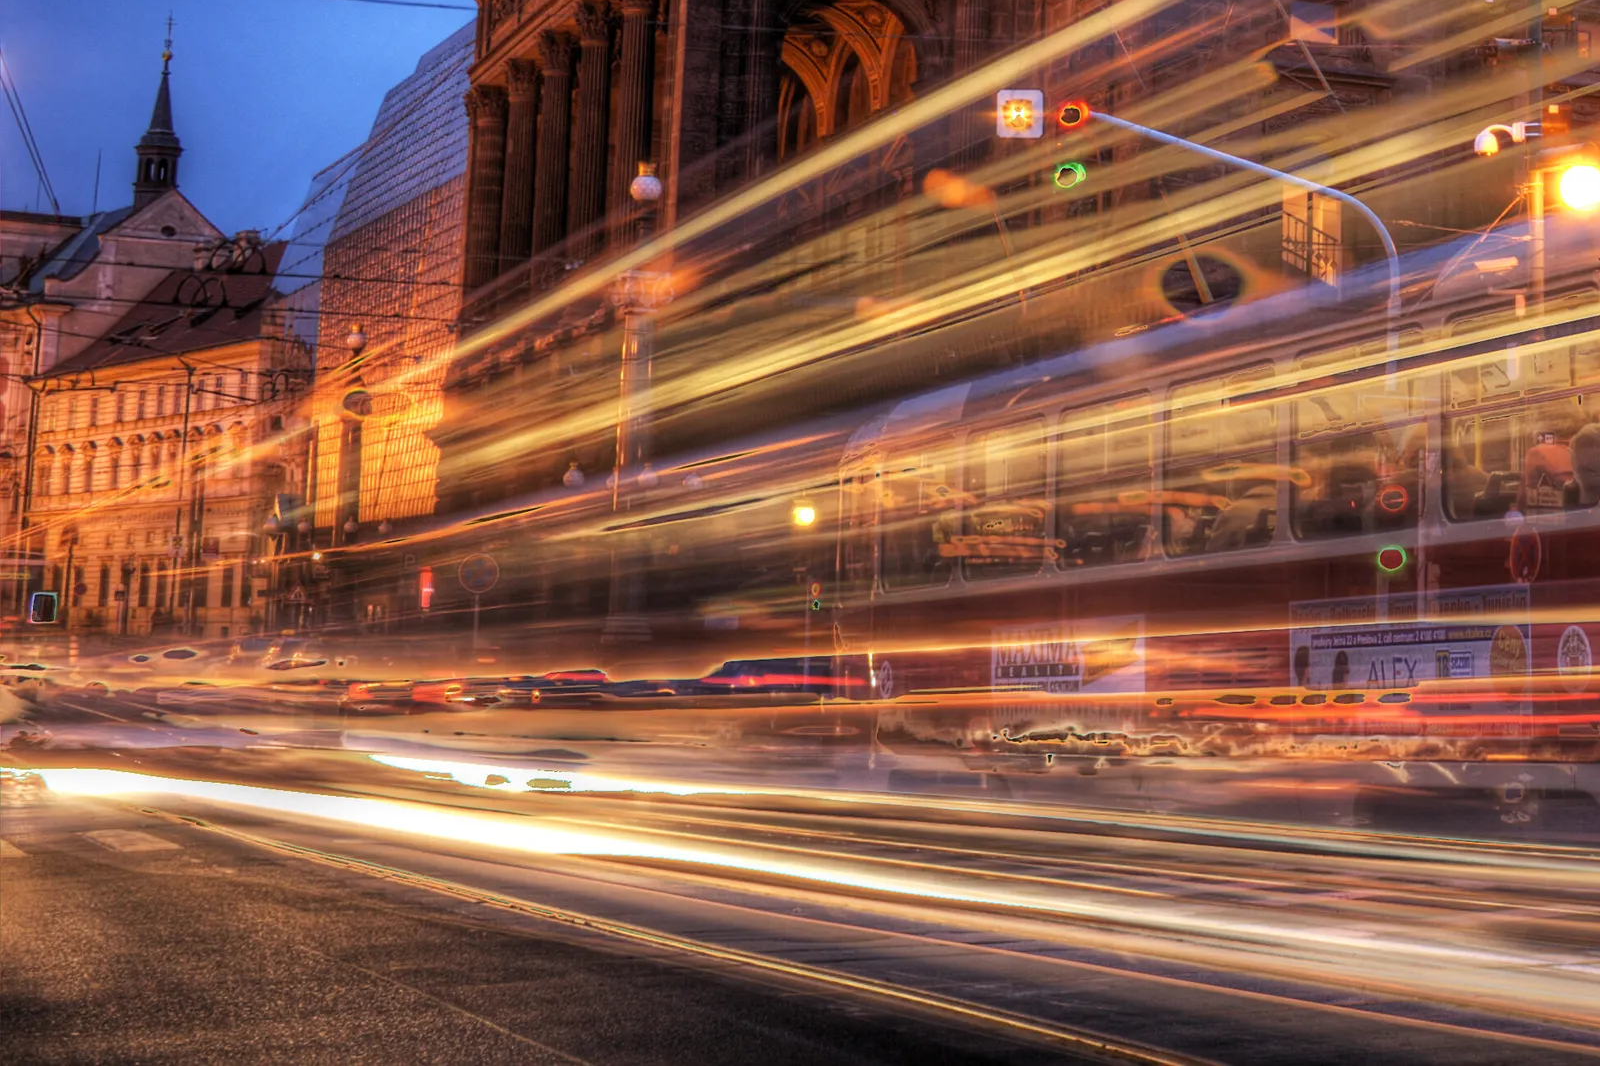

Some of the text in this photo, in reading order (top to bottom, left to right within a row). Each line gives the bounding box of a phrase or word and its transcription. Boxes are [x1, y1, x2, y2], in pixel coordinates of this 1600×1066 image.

[996, 626, 1080, 666] MAXIMA
[997, 664, 1078, 678] REALITY
[1367, 656, 1418, 689] ALEX
